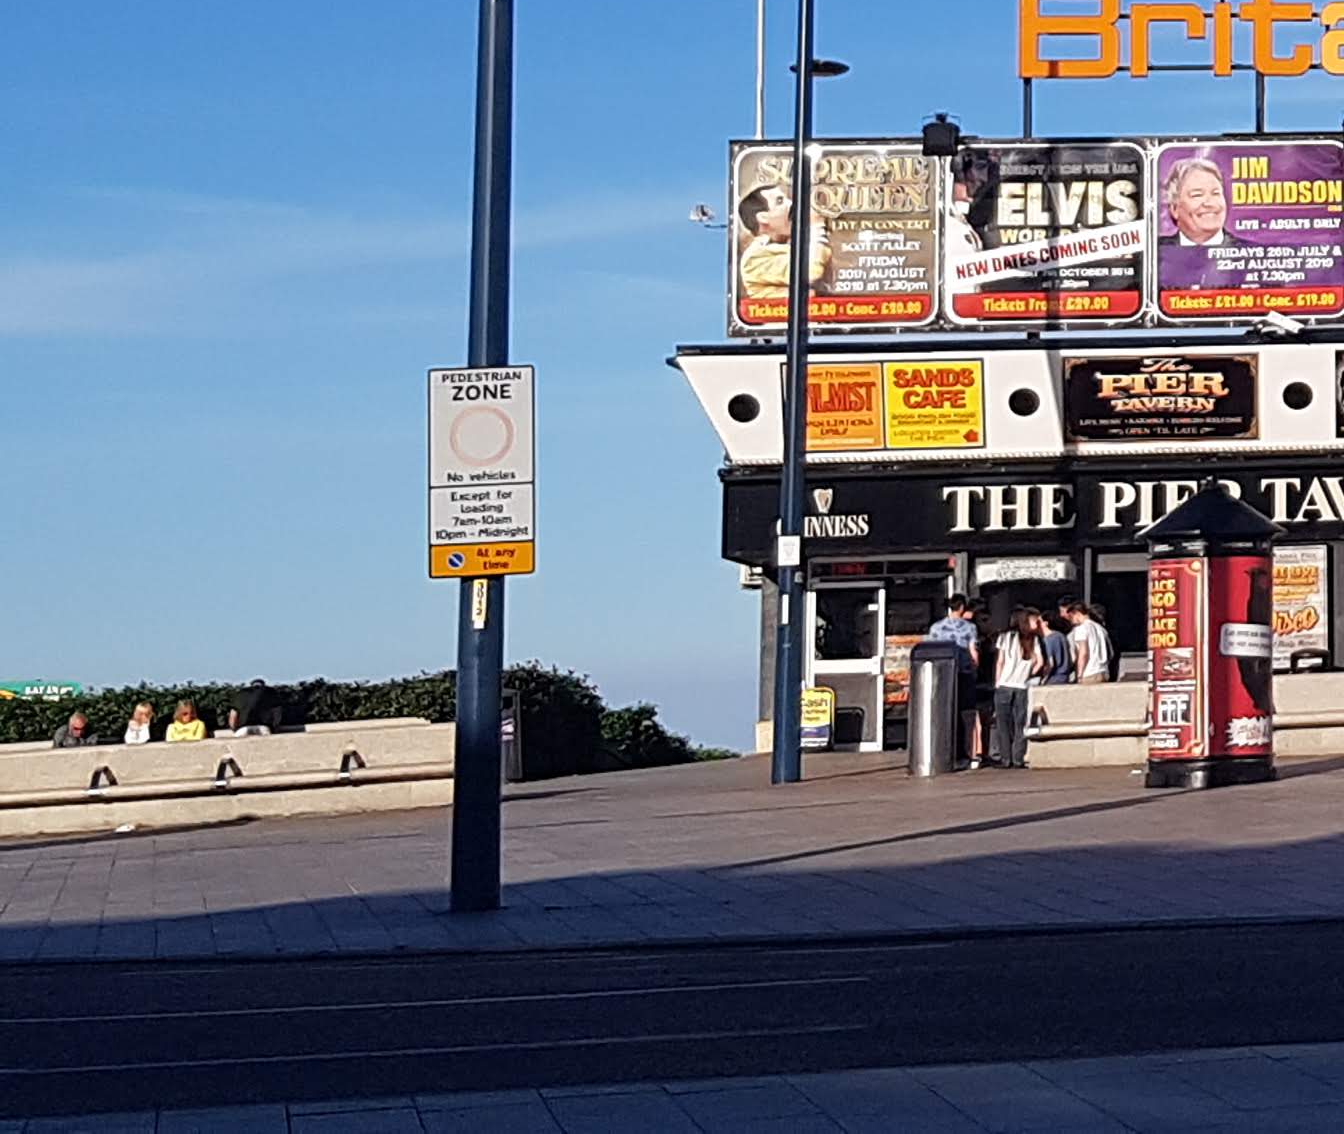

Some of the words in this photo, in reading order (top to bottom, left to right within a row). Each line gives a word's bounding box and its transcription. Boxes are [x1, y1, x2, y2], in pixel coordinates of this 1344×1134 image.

[1233, 156, 1269, 180] JIM
[1232, 179, 1343, 206] DAVIDSON
[811, 183, 929, 218] QUEEN
[998, 179, 1138, 225] ELVIS
[861, 220, 873, 230] IN
[875, 219, 931, 230] CONCERT
[956, 257, 990, 279] NEW
[992, 250, 1038, 273] DATES
[1040, 238, 1099, 263] COMING
[1100, 229, 1141, 252] SOON
[1208, 247, 1265, 259] FRIDAYS
[1297, 246, 1330, 258] JULY
[859, 256, 906, 267] FRIDAY
[1247, 259, 1302, 270] AUGUST
[870, 268, 926, 279] AUGUST
[983, 298, 1026, 312] Tickets
[1141, 357, 1193, 372] The
[441, 371, 522, 384] PEDESTRIAN
[893, 368, 975, 388] SANDS
[1094, 371, 1229, 398] PIER
[452, 384, 512, 401] ZONE
[809, 381, 876, 413] LMIST
[903, 390, 967, 410] CAFE
[1110, 397, 1217, 413] TAVERN
[447, 472, 464, 483] No
[469, 471, 516, 482] vehicles
[451, 491, 490, 503] Except
[496, 490, 513, 500] for
[942, 482, 1076, 532] THE
[478, 526, 529, 539] Midnight
[777, 514, 870, 538] INNESS
[476, 548, 490, 558] At
[495, 548, 516, 559] any
[483, 560, 510, 570] time
